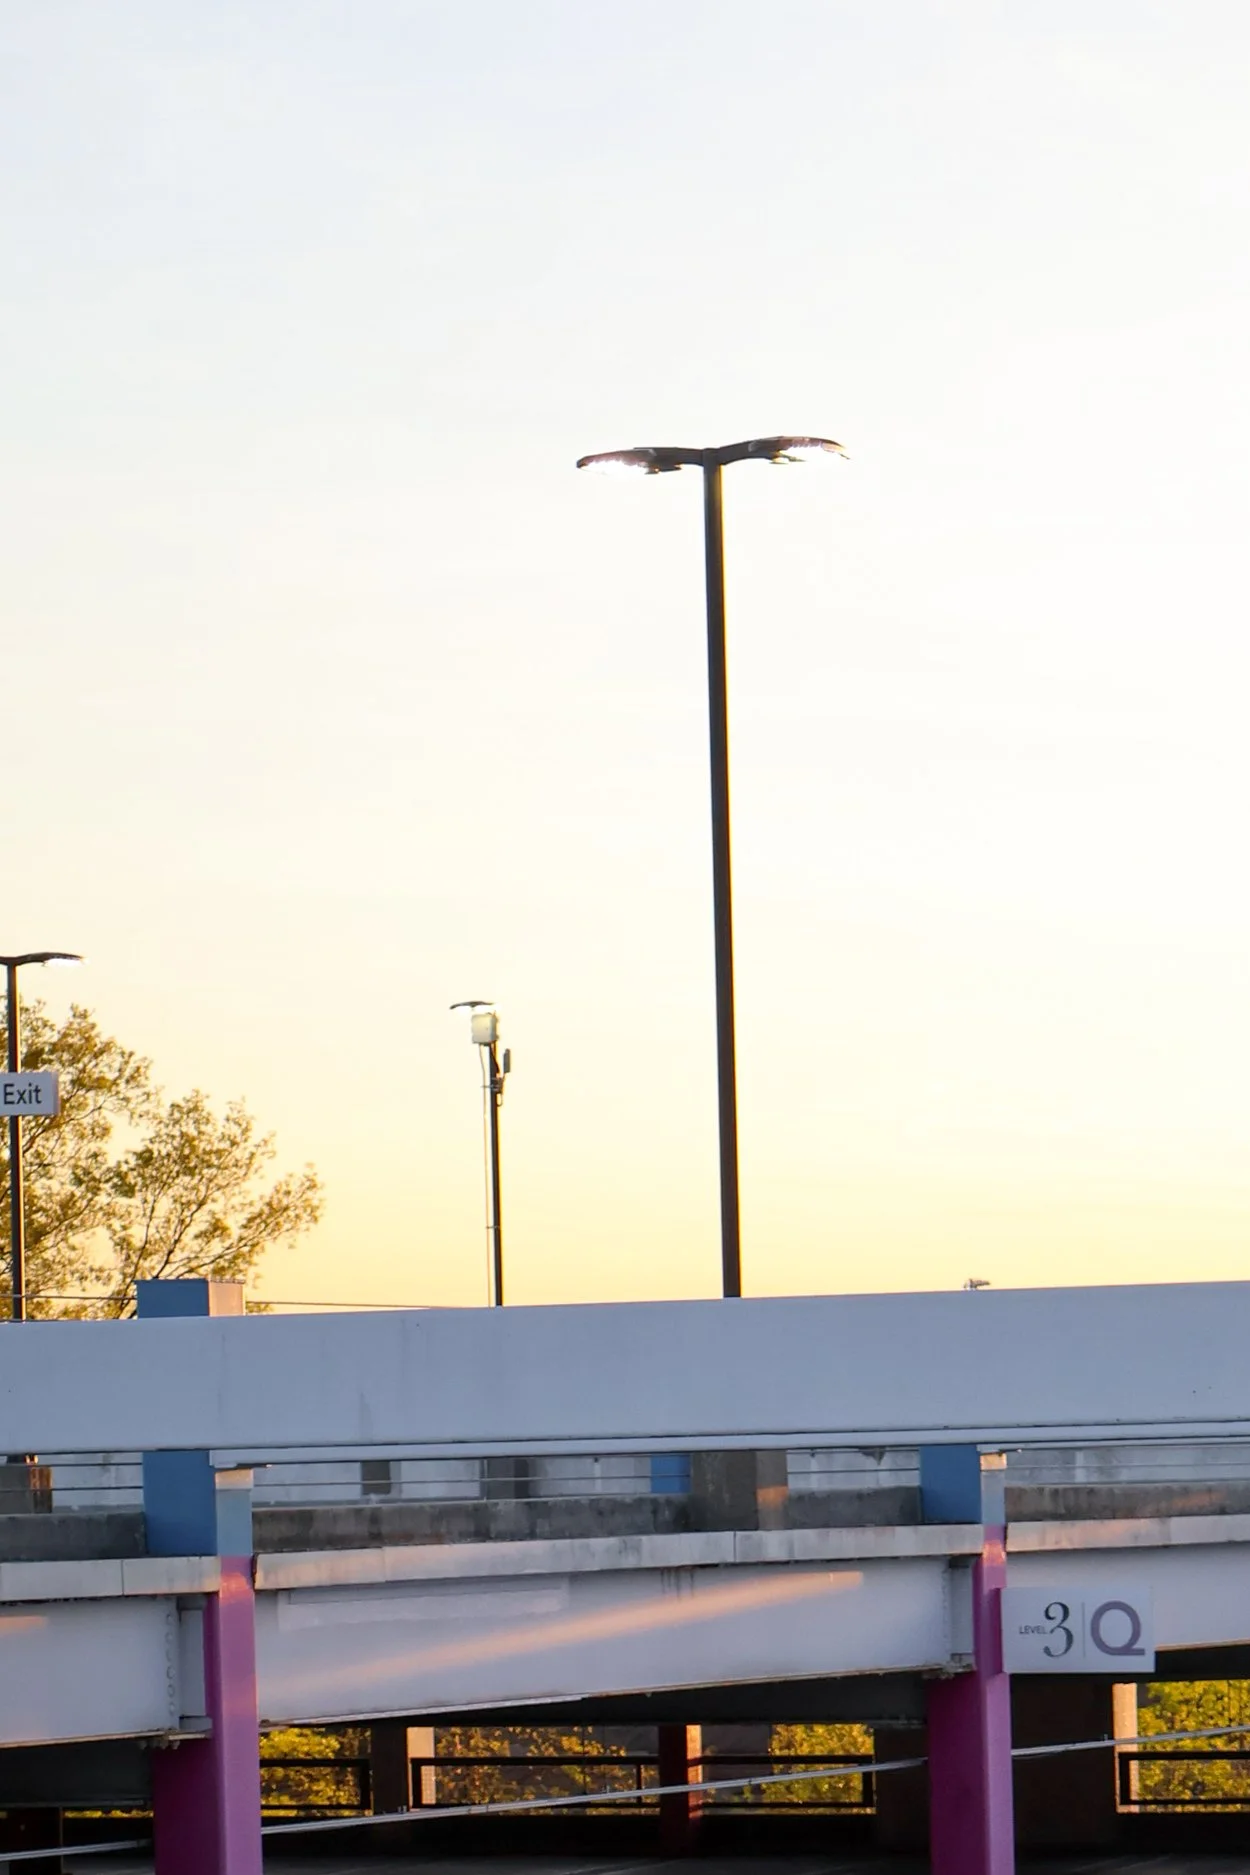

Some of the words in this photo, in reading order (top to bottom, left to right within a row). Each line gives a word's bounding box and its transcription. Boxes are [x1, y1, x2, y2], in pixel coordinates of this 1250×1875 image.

[3, 1082, 42, 1105] Exit
[1019, 1625, 1047, 1635] LEVEL
[1043, 1601, 1074, 1658] 3
[1090, 1600, 1145, 1656] Q
